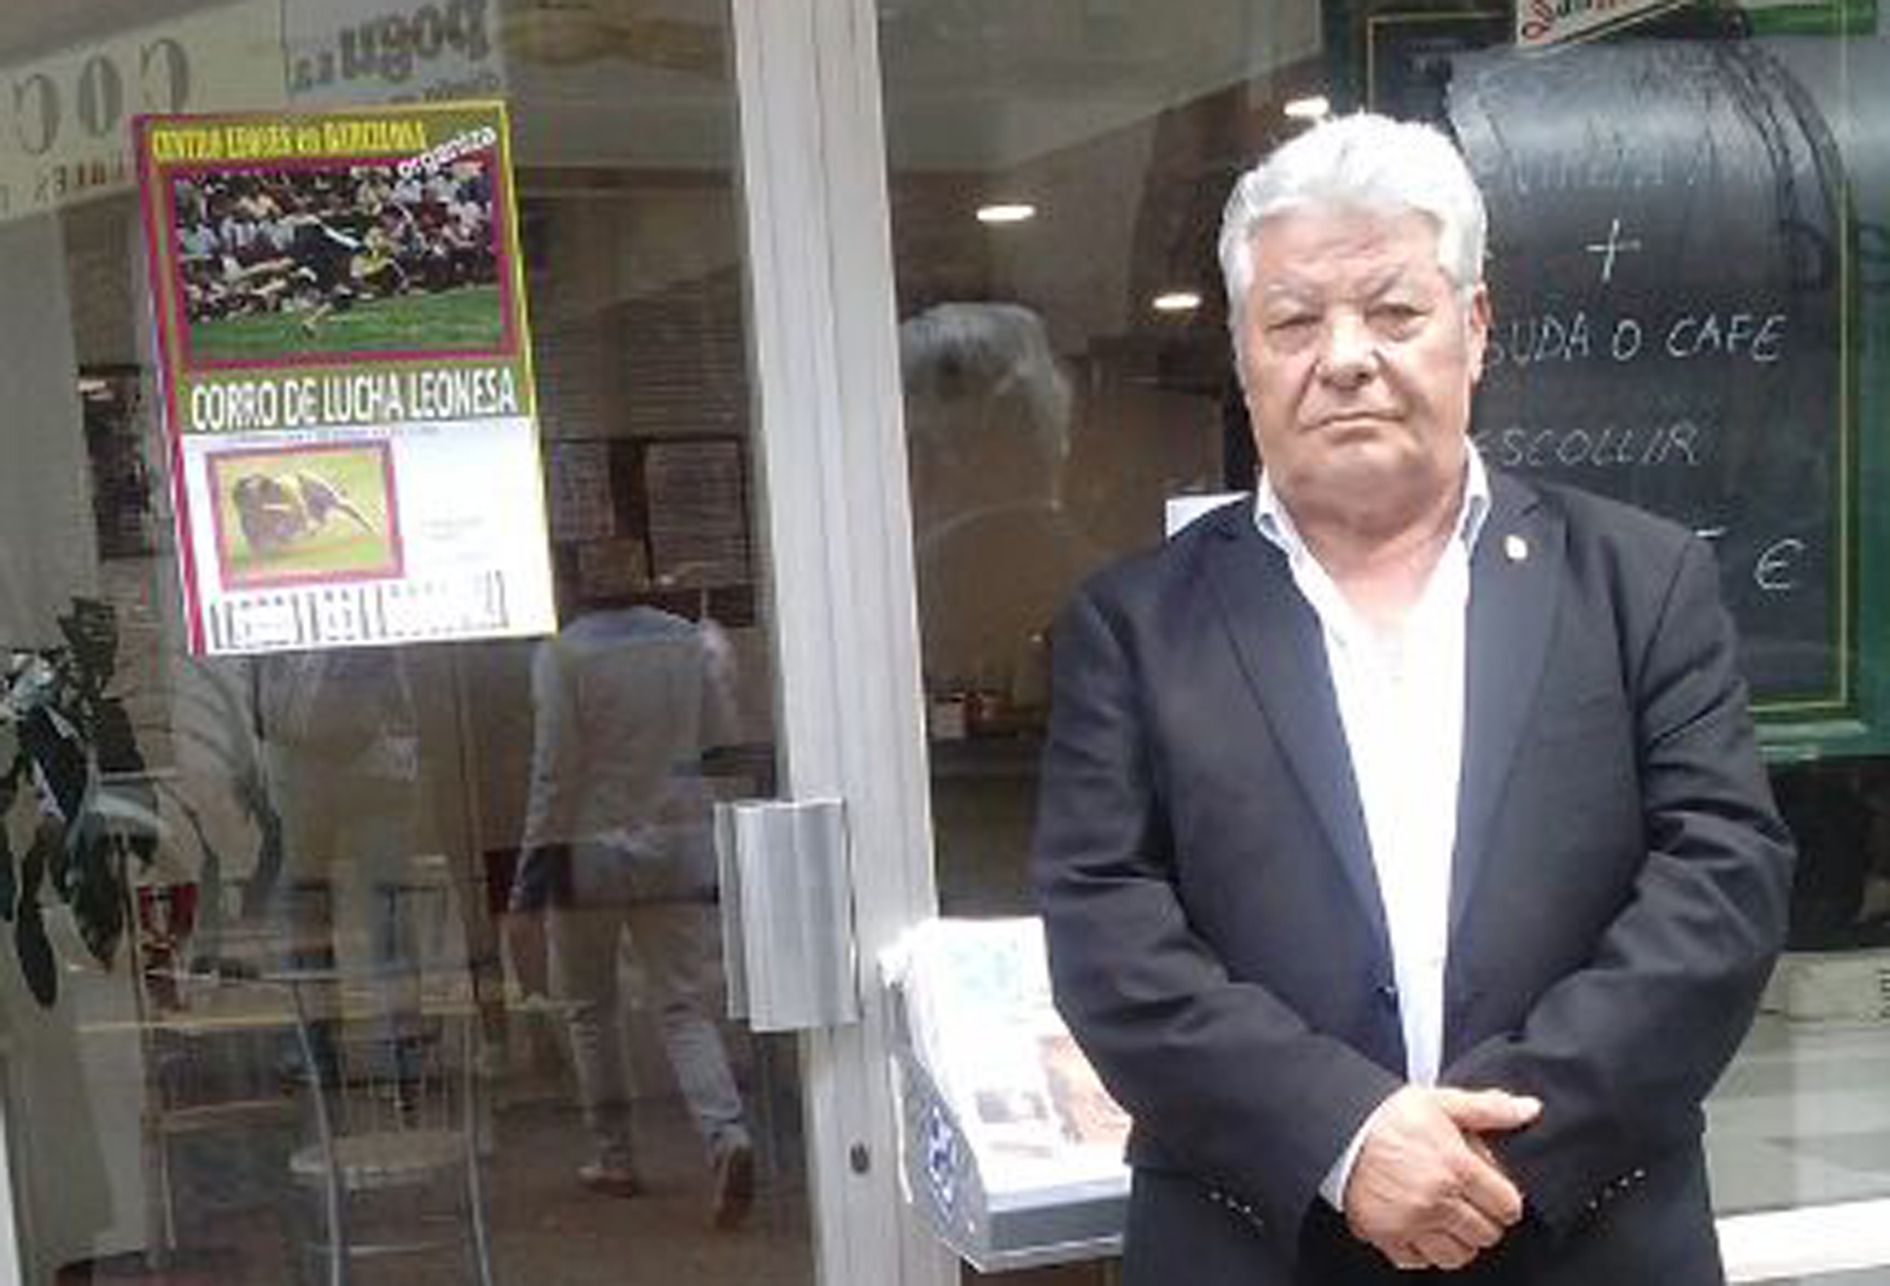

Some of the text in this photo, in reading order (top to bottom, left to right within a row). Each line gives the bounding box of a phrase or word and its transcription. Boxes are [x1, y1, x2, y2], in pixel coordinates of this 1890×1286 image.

[397, 125, 497, 178] organiza
[1665, 314, 1788, 362] CAFE
[191, 369, 517, 430] CORRO DE LUCHA LEONESA
